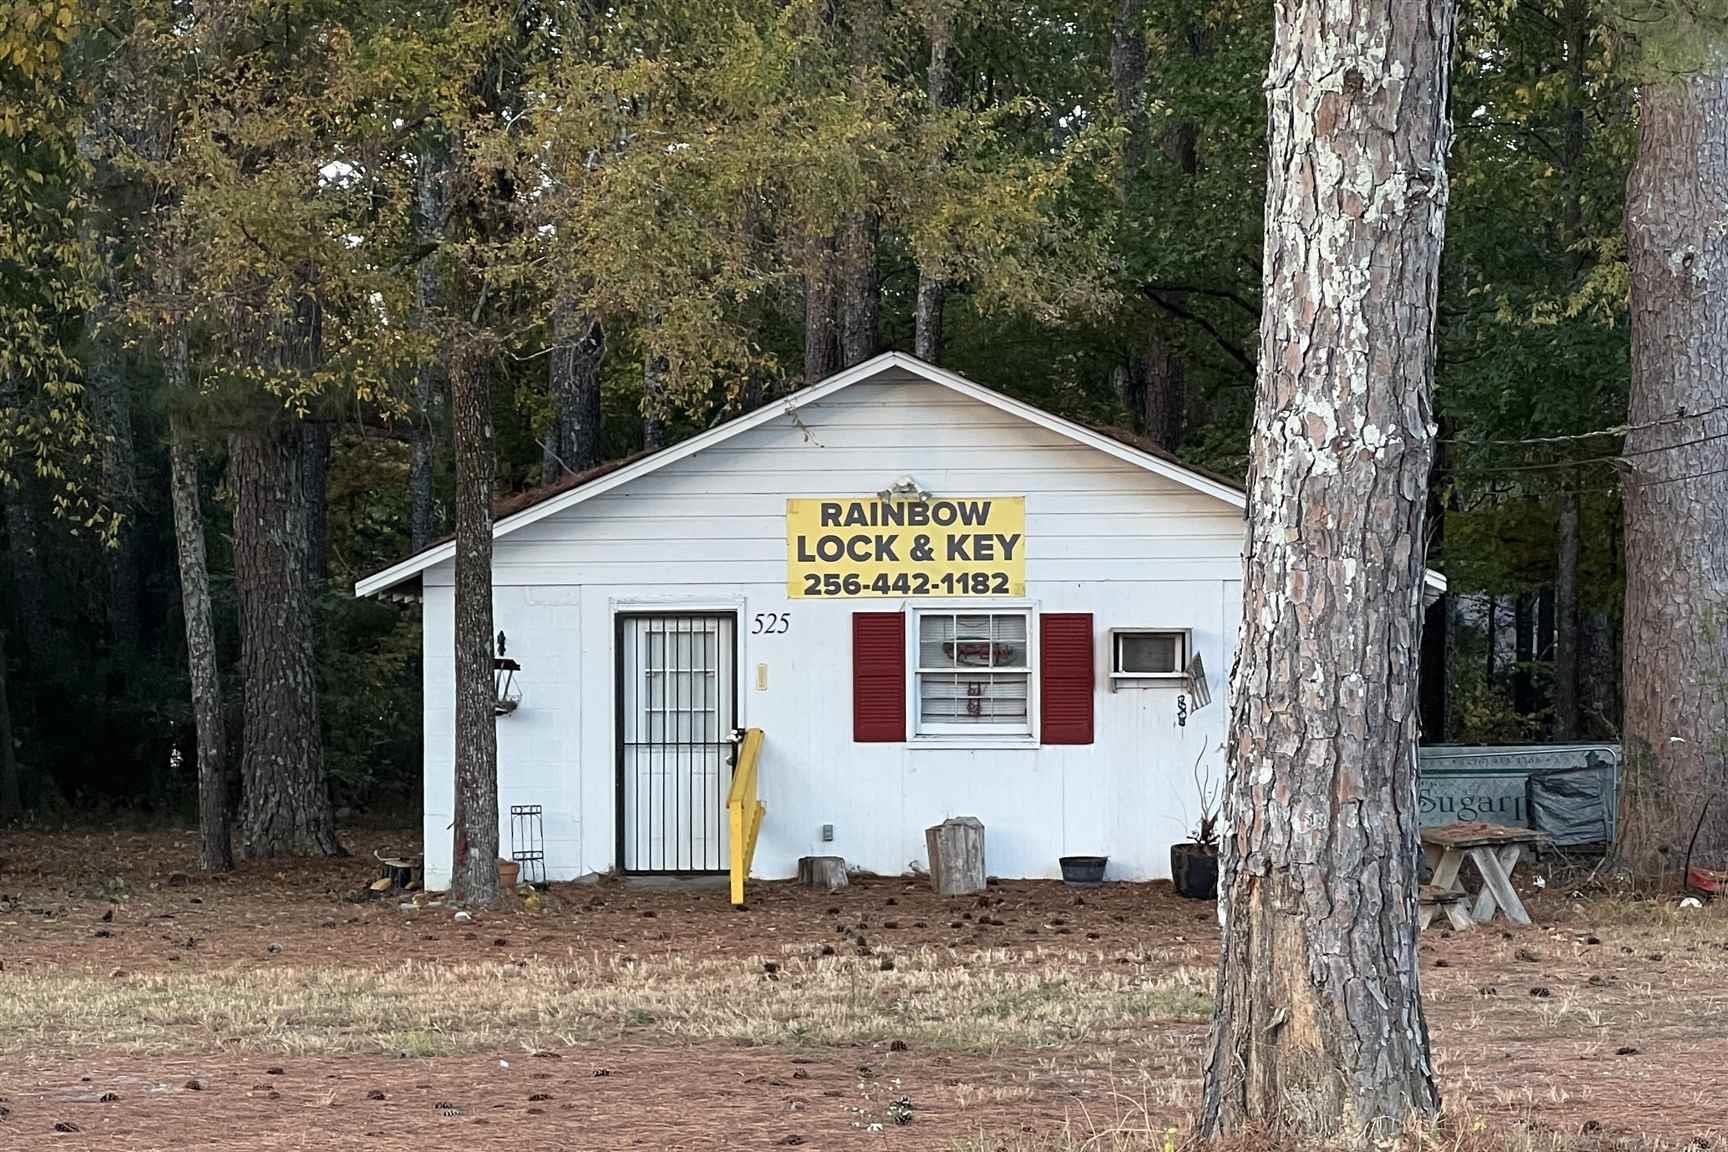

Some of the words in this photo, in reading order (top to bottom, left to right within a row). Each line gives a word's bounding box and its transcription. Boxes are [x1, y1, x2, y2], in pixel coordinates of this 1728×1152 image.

[820, 502, 991, 527] RAINBOW
[797, 535, 900, 562] LOCK
[909, 534, 935, 562] &
[946, 534, 1021, 562] KEY
[803, 573, 1010, 596] 256-442-1182
[751, 613, 791, 634] 525
